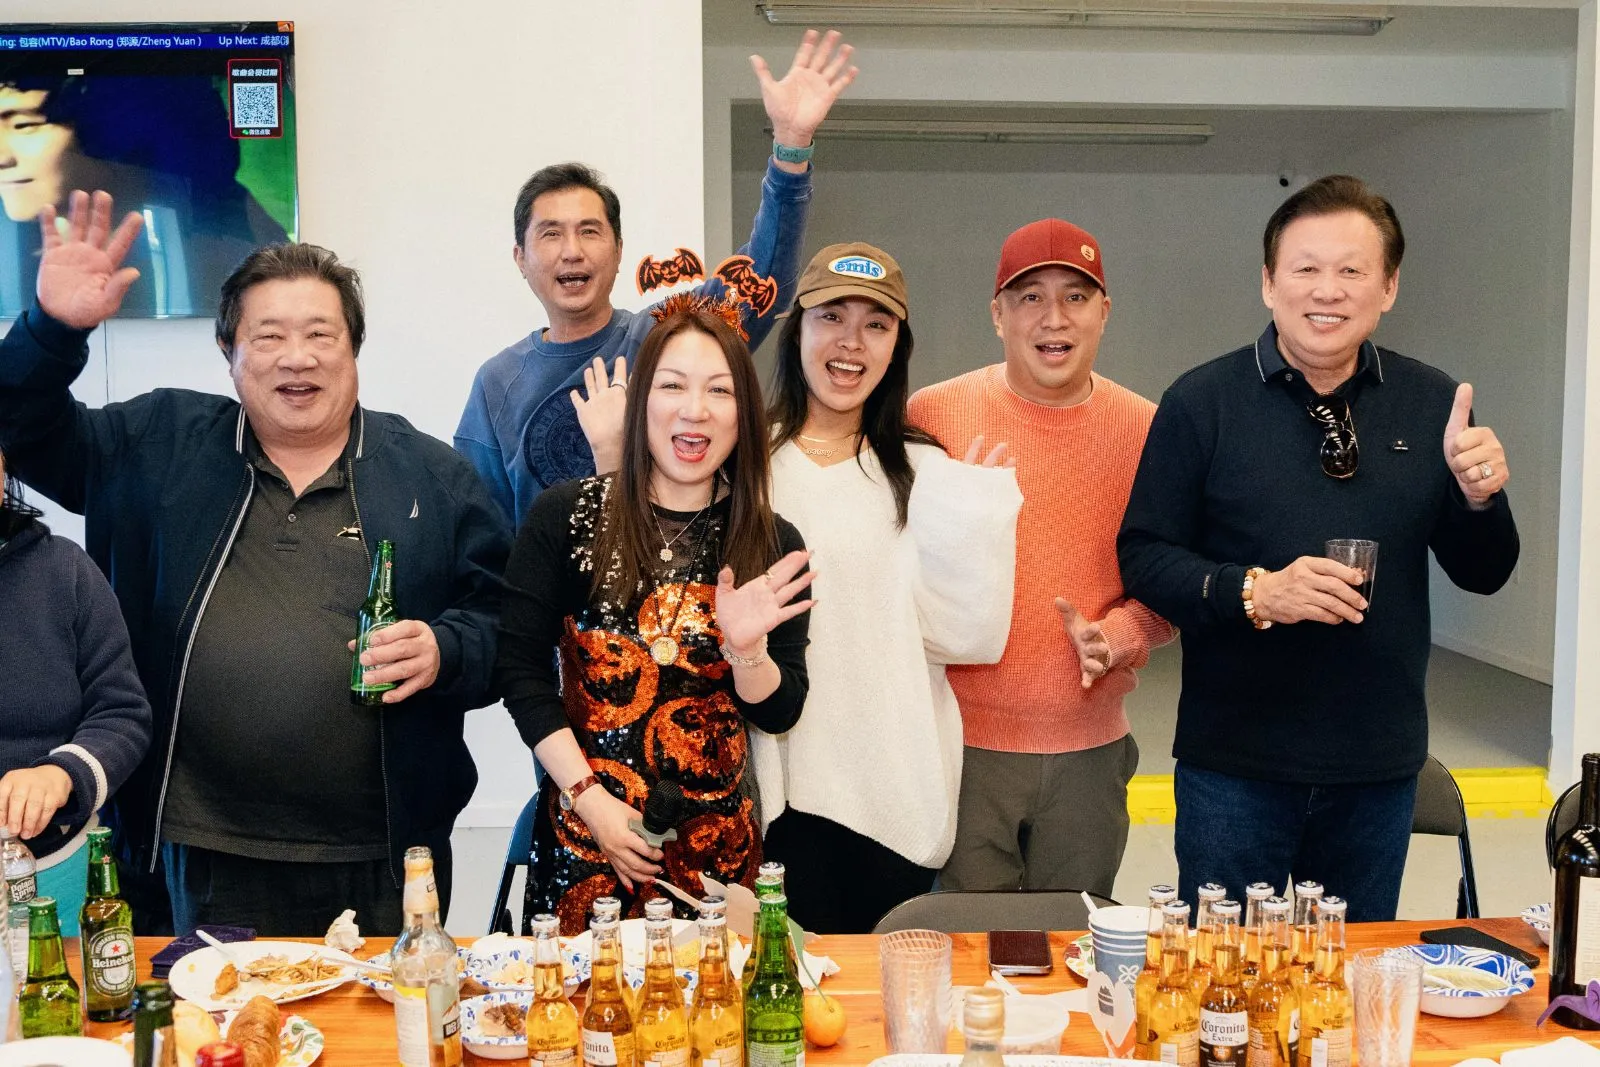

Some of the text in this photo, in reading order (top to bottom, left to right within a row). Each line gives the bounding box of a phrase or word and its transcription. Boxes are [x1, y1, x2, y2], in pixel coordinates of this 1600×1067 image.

[89, 37, 114, 49] Rong
[173, 36, 196, 46] Yuan
[198, 36, 202, 47] )
[218, 35, 233, 47] Up
[235, 35, 258, 46] Next:
[834, 259, 880, 278] emis
[1201, 1017, 1245, 1034] Coronita
[1212, 1033, 1233, 1042] Extra
